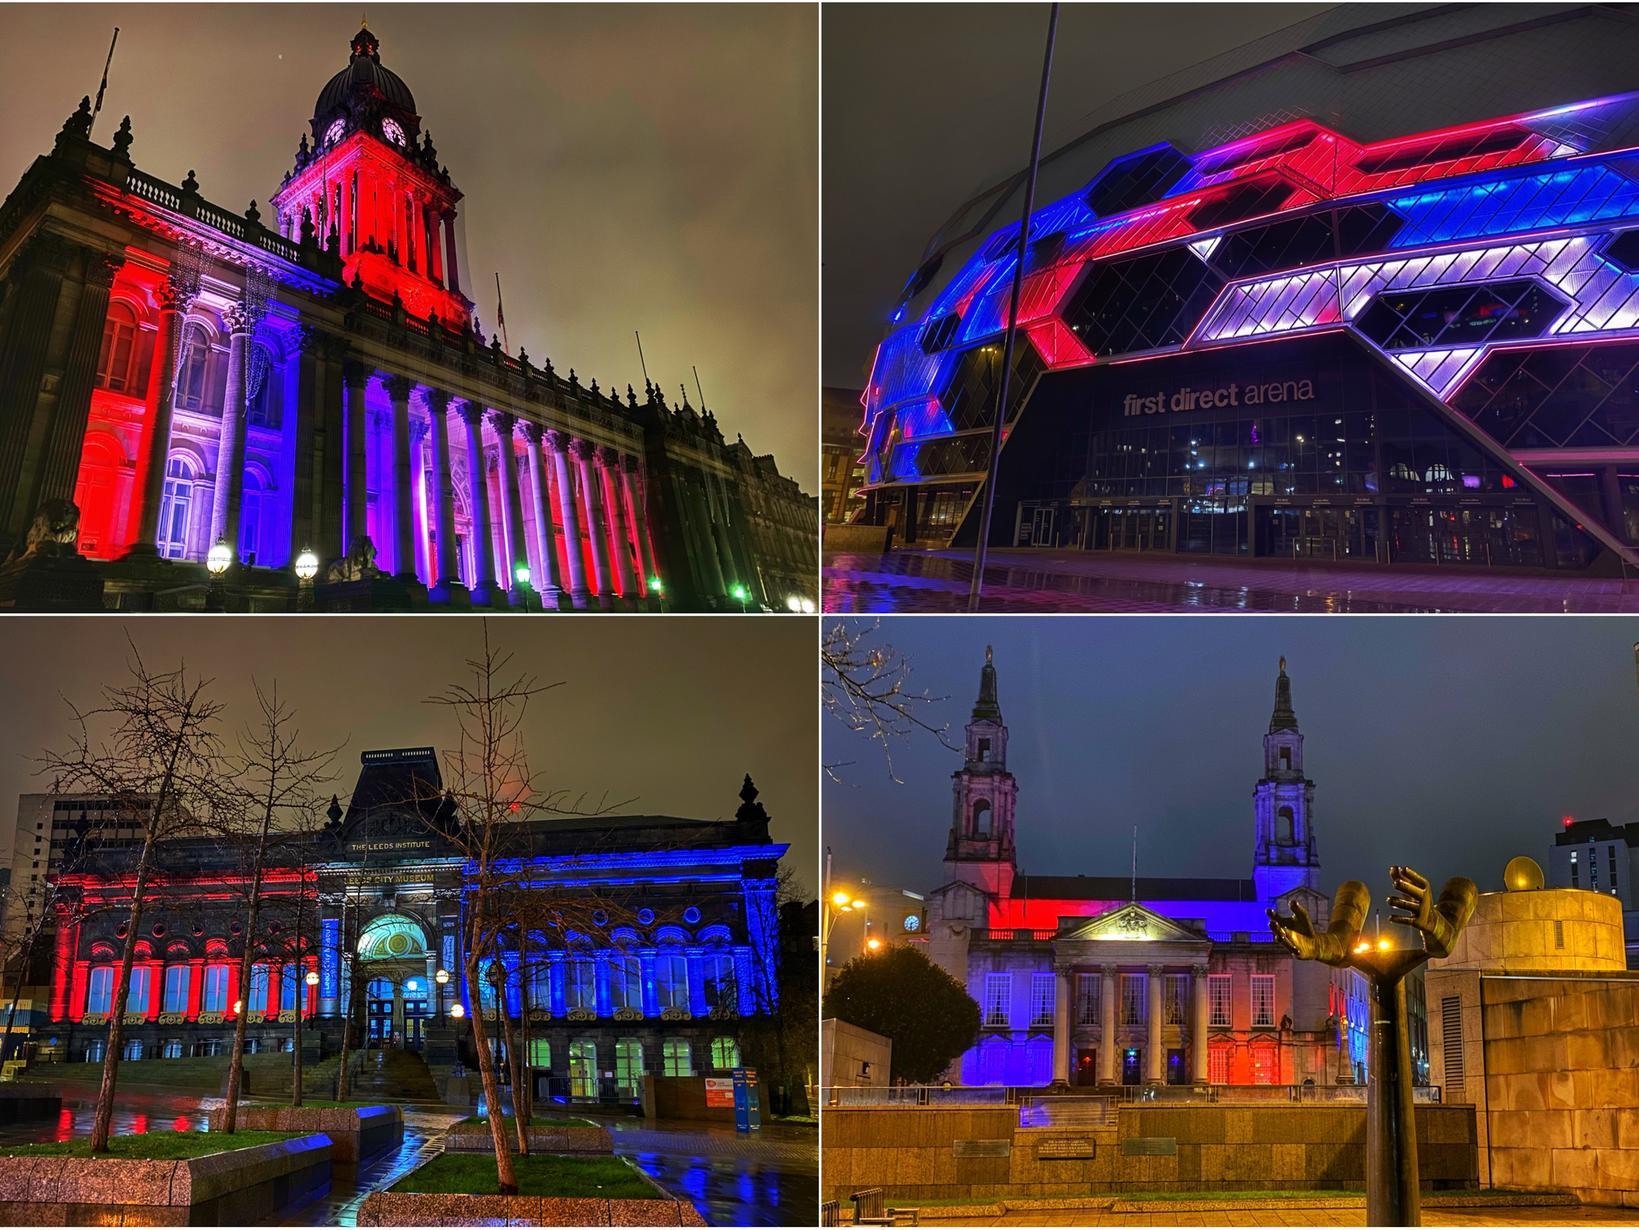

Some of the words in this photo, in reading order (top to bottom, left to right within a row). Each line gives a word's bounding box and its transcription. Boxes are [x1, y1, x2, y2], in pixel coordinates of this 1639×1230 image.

[1123, 391, 1166, 417] first
[1170, 383, 1239, 412] direct
[1244, 379, 1315, 405] arena
[395, 841, 430, 849] INSTITUTE
[374, 875, 394, 884] CITY
[395, 874, 434, 883] MUSEUM
